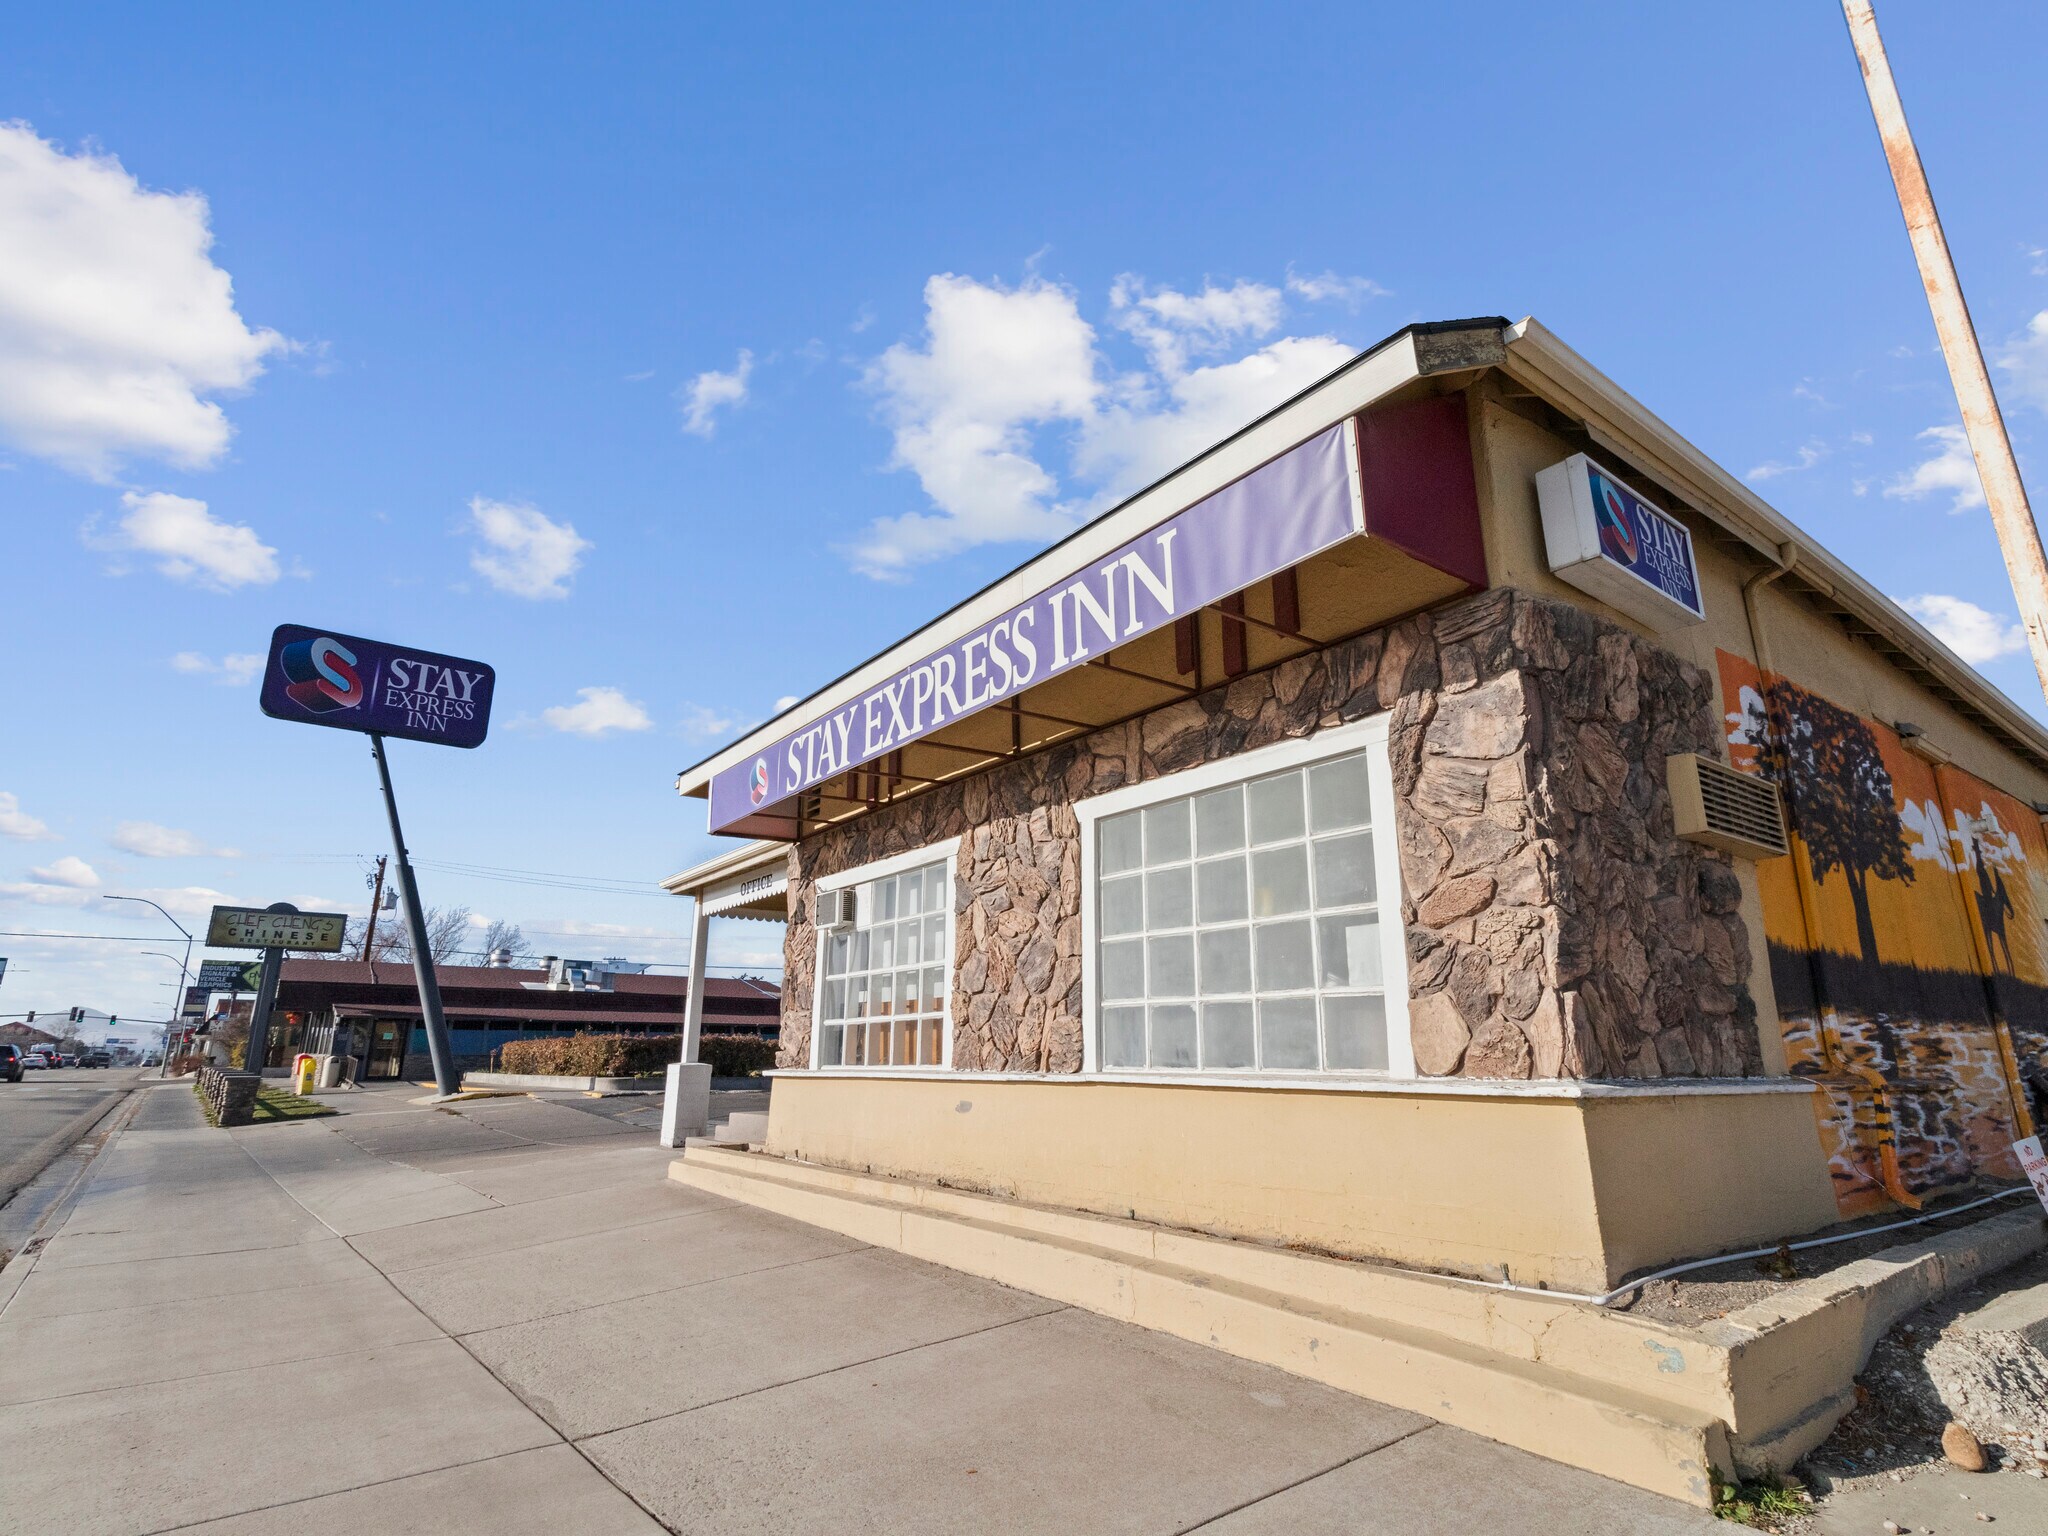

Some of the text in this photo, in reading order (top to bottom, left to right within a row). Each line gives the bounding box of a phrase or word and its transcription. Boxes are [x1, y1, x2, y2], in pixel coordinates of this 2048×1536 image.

[1636, 504, 1686, 568] STAY
[1642, 542, 1692, 592] EXPRESS
[1659, 574, 1682, 603] INN
[787, 528, 1177, 793] STAY EXPRESS INN
[387, 658, 484, 702] STAY
[384, 689, 476, 720] EXPRESS
[406, 712, 448, 732] INN
[740, 874, 773, 896] OFFICE
[228, 928, 329, 941] CHINESE
[240, 937, 316, 946] RESTAURANT
[2024, 1157, 2047, 1174] PARKING
